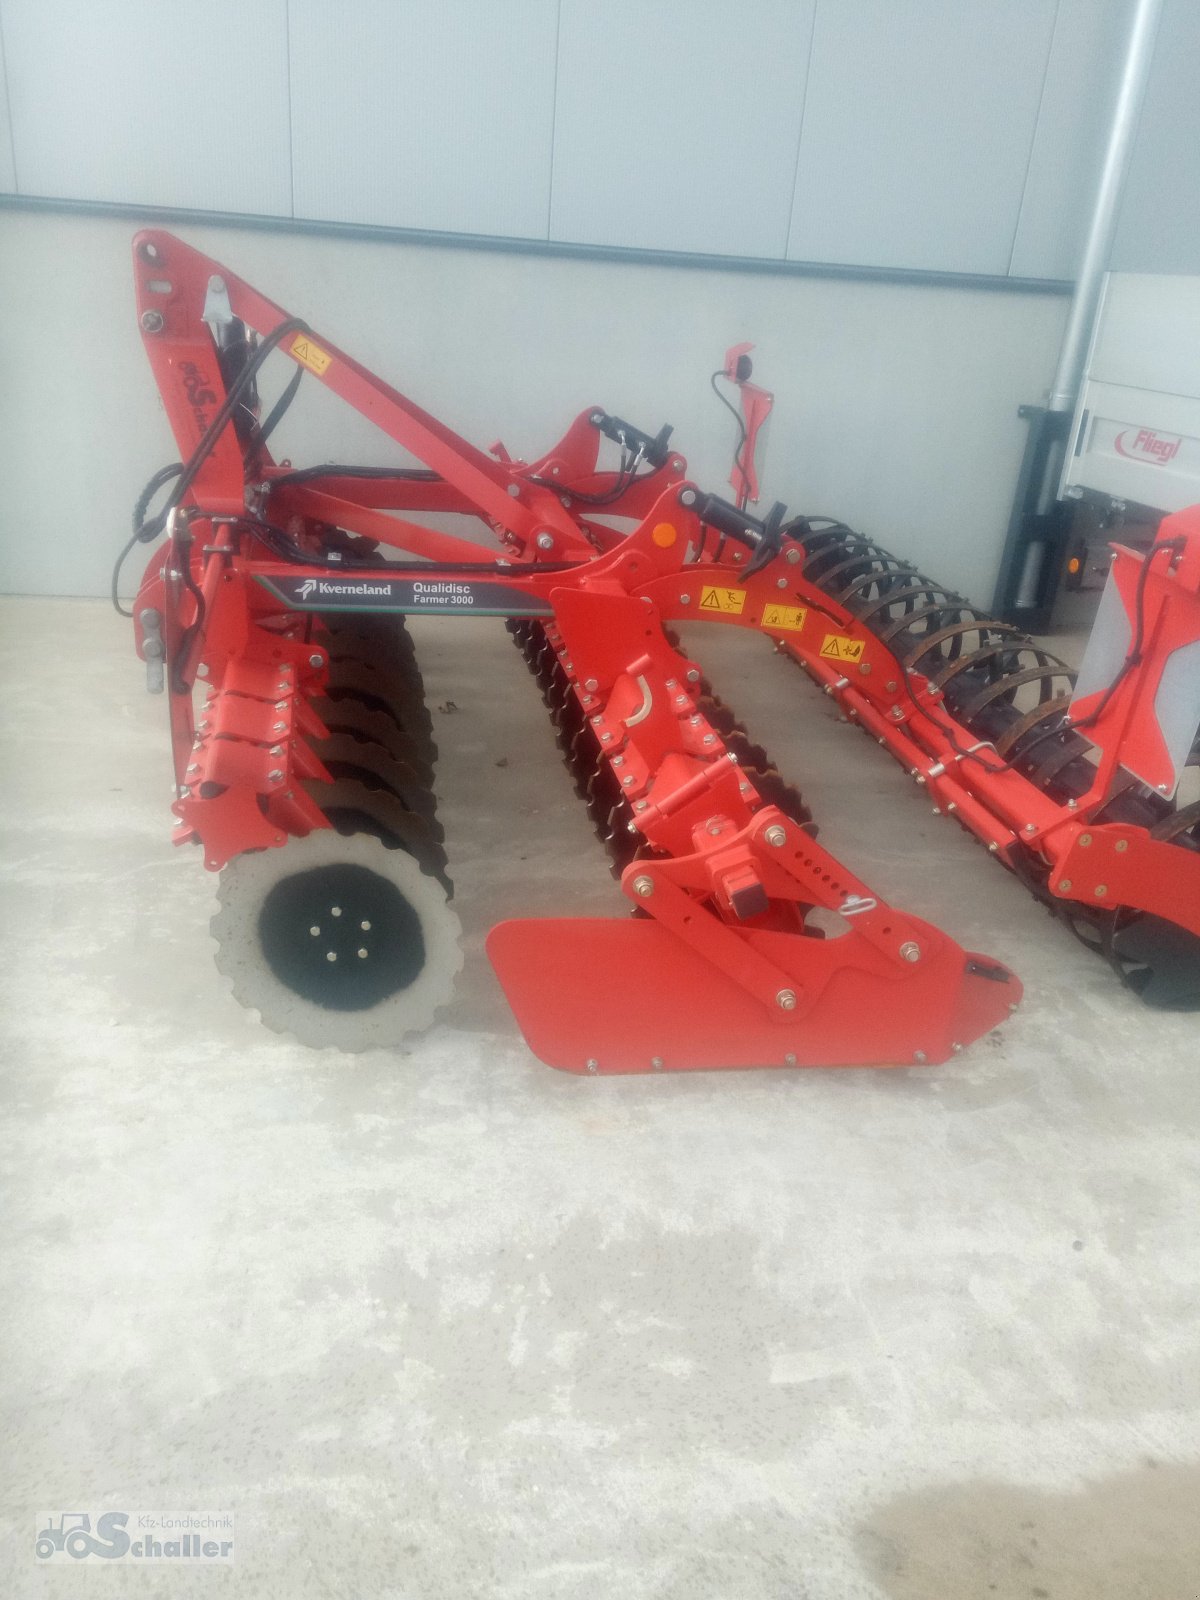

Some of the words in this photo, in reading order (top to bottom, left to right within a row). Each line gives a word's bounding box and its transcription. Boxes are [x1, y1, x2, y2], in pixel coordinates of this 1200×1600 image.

[1132, 430, 1182, 462] Fliegl
[319, 582, 392, 596] Kverneland
[413, 582, 471, 594] Qualidisc
[413, 595, 449, 604] Farmer
[450, 595, 474, 605] 3000
